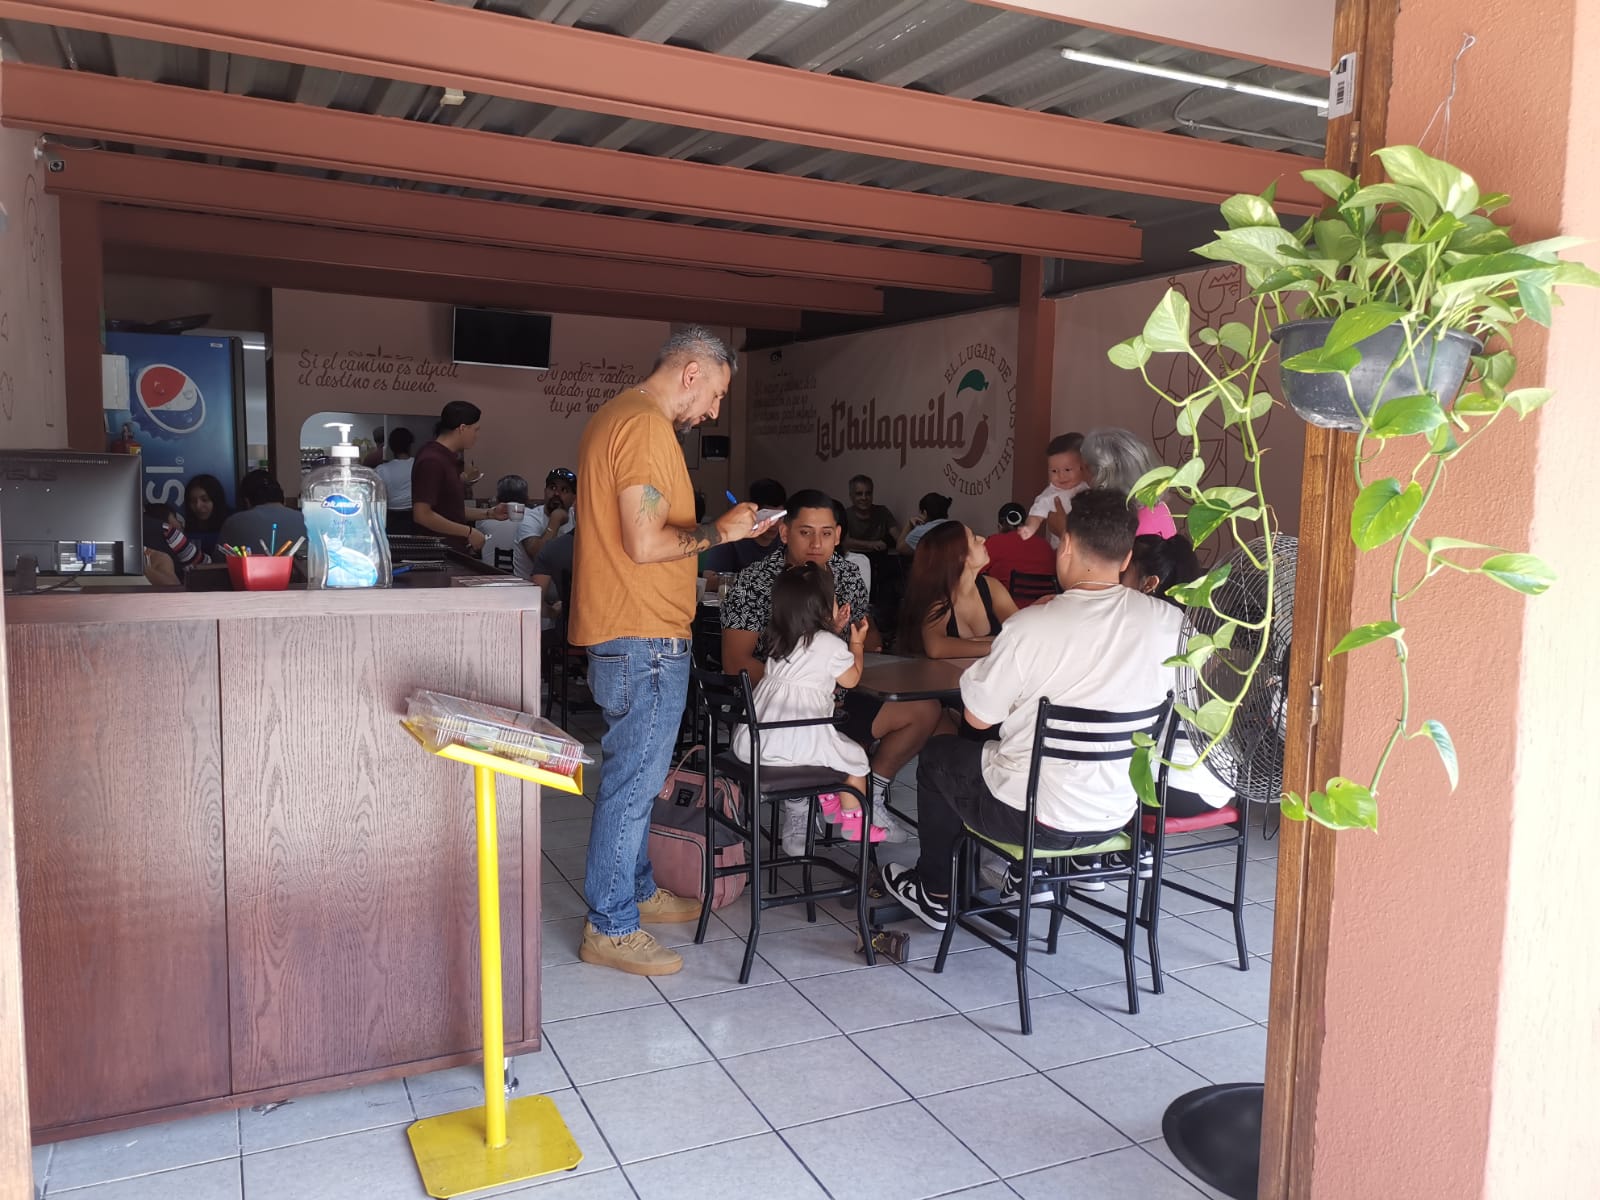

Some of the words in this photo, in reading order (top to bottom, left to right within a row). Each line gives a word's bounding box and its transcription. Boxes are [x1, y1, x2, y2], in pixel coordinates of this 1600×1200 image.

[298, 348, 319, 369] Si
[322, 352, 338, 370] el
[339, 358, 394, 374] camino
[396, 363, 412, 375] es
[958, 344, 996, 365] LUGAR
[561, 363, 593, 384] poder
[600, 367, 635, 384] radica
[944, 362, 960, 384] EL
[998, 356, 1012, 383] DE
[315, 371, 370, 389] destino
[373, 379, 388, 391] es
[566, 402, 581, 419] ya
[831, 391, 966, 468] Chilaquila
[943, 437, 1015, 496] CHILAQUILES
